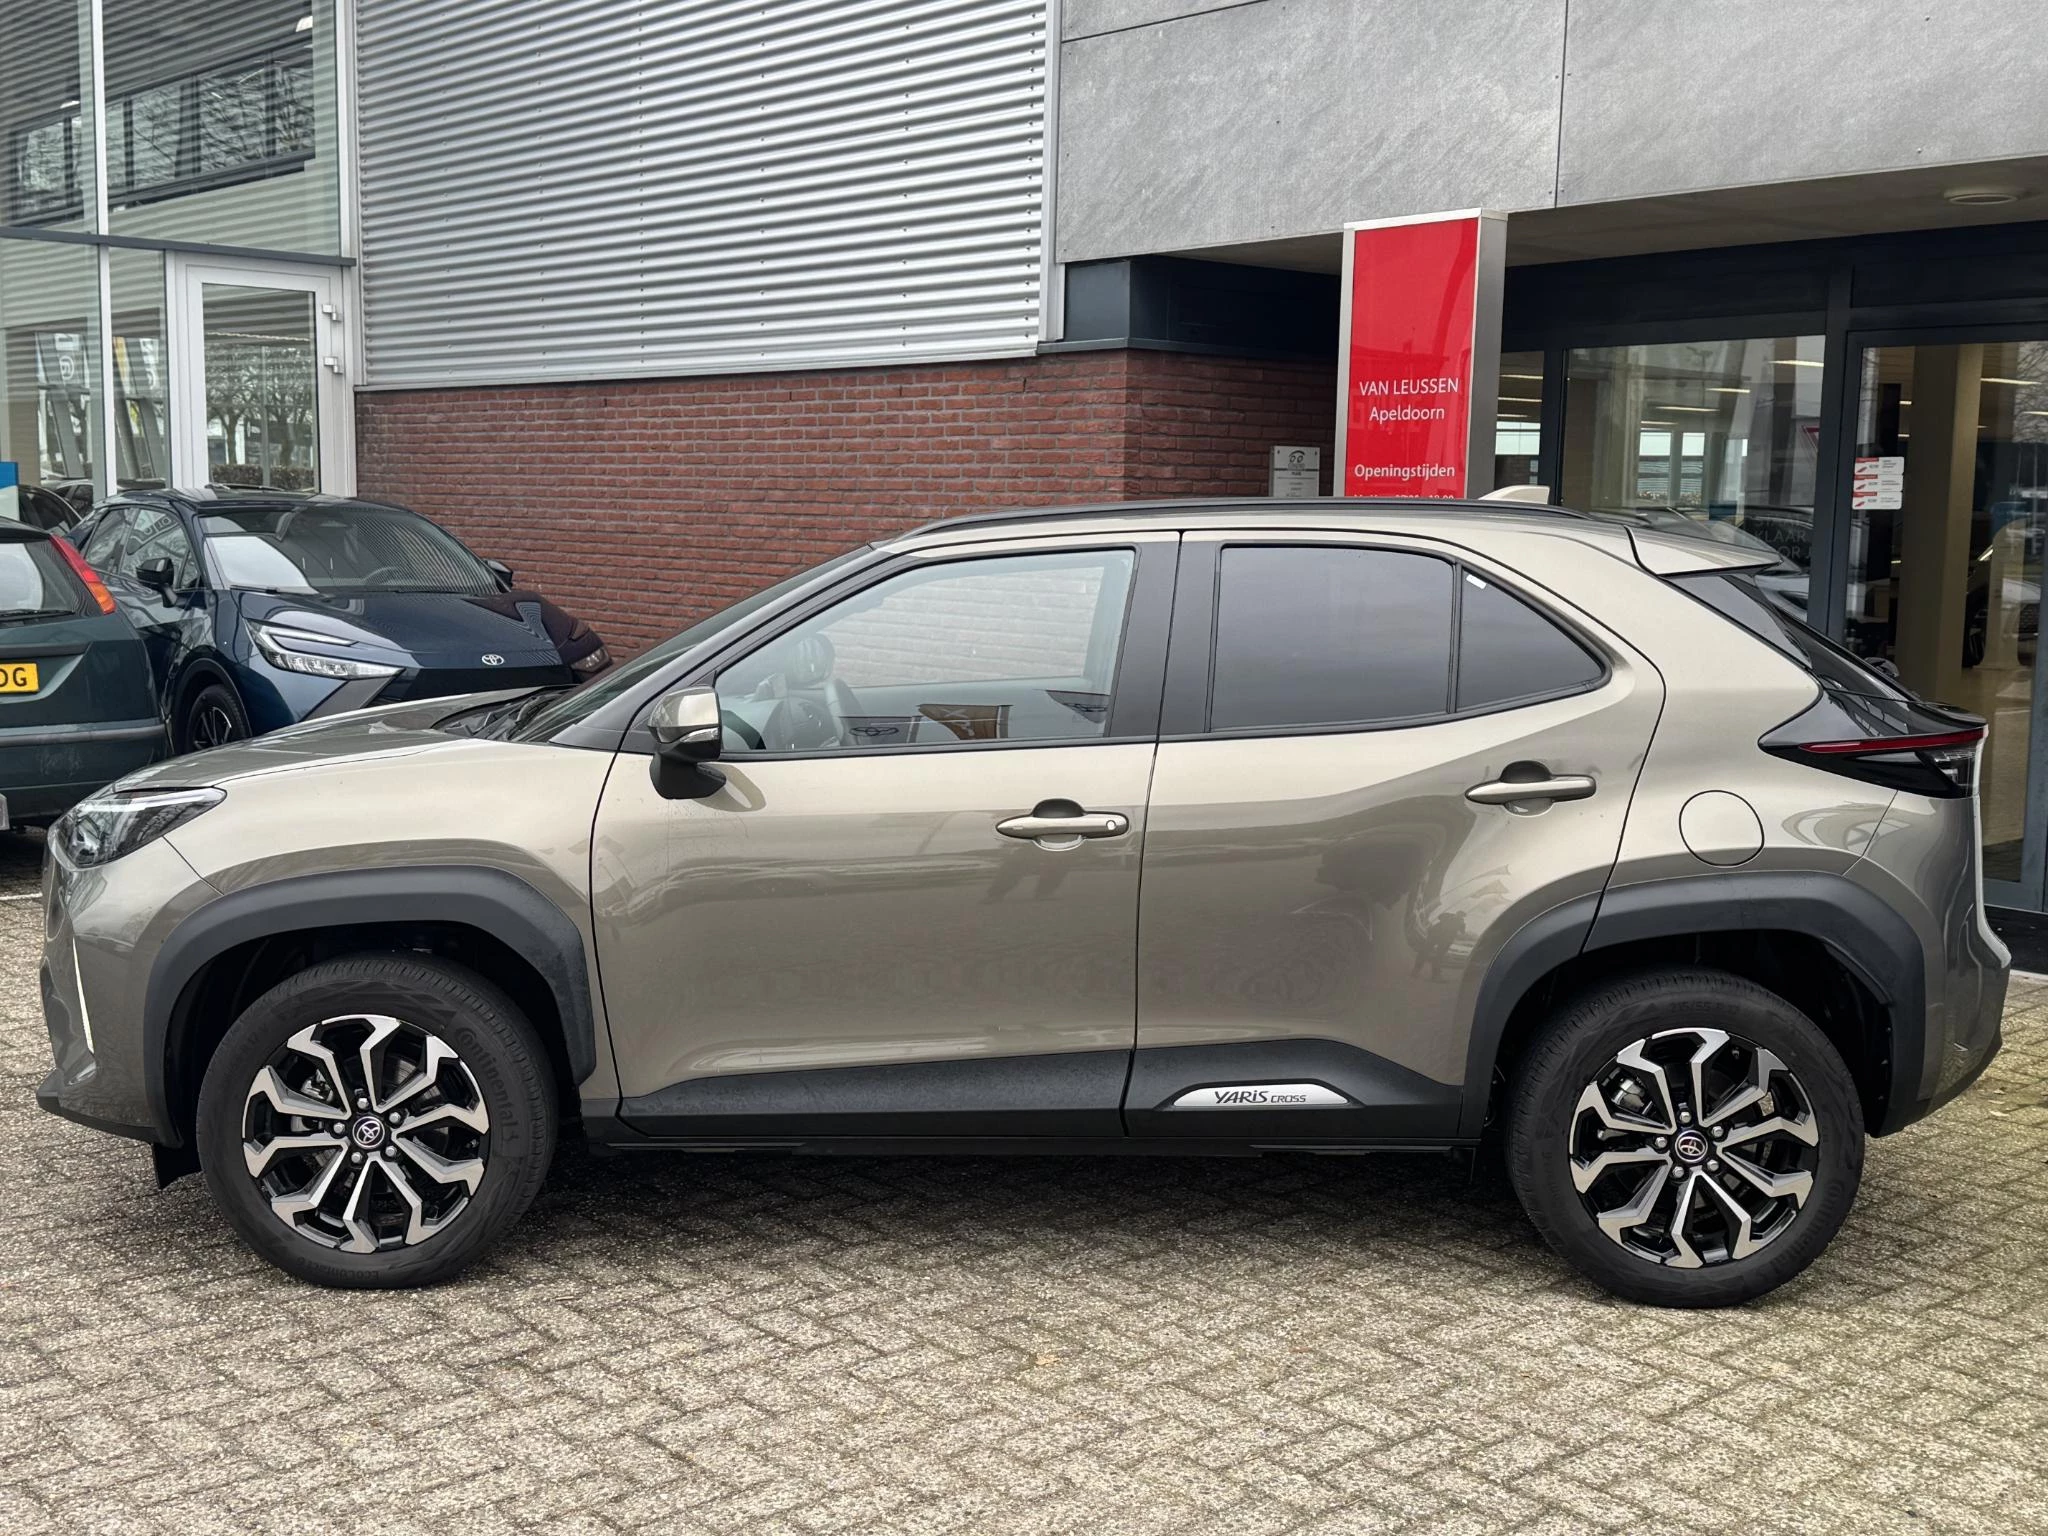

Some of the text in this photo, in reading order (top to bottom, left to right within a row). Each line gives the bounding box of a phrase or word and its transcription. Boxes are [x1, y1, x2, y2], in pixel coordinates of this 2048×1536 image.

[1359, 378, 1459, 396] VAN LEUSSEN
[1369, 404, 1445, 424] Apeldoorn
[1354, 464, 1455, 481] Openingstijden
[456, 1027, 519, 1128] Continental
[1270, 1095, 1307, 1104] CROSS
